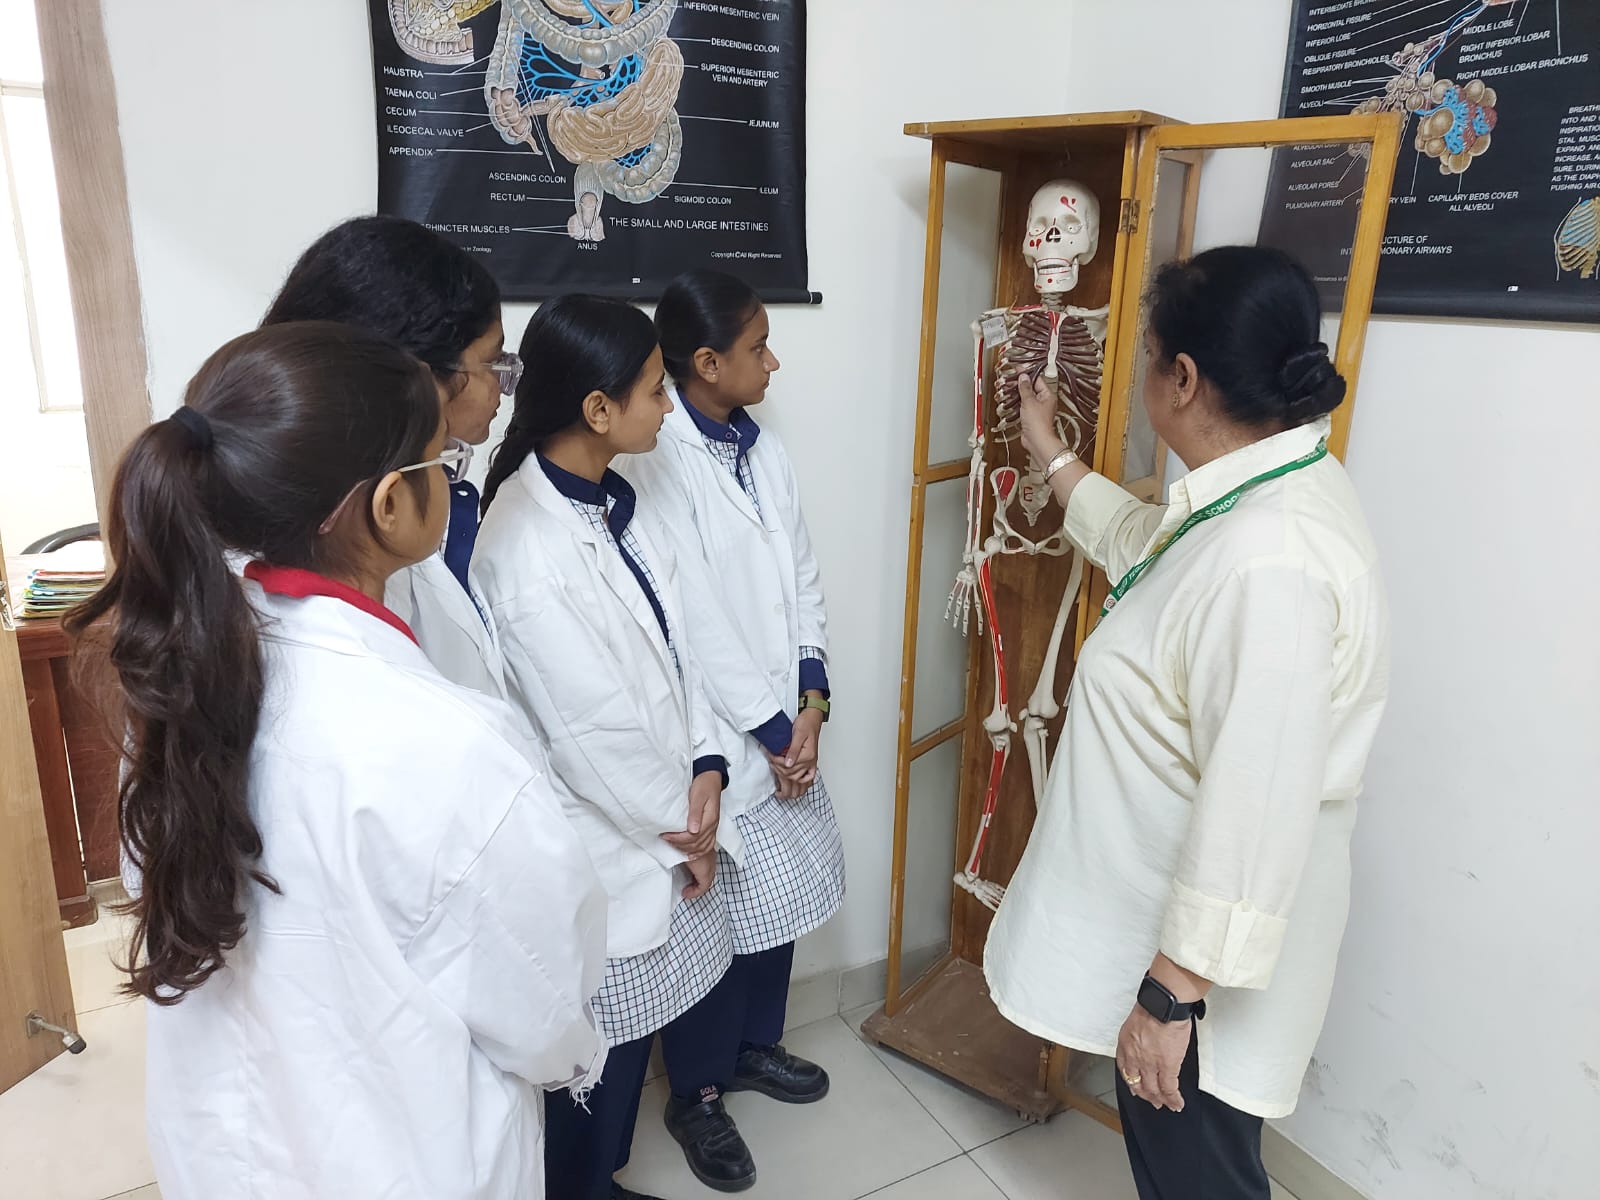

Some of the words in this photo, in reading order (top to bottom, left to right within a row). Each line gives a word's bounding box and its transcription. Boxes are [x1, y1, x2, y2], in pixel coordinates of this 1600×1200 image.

[684, 2, 718, 12] INFERIOR
[720, 6, 760, 19] MESENTERIC
[762, 12, 780, 21] VEIN
[1307, 19, 1345, 32] HORIZONTAL
[1346, 13, 1372, 24] FISSURE
[1462, 23, 1493, 35] MIDDLE
[1493, 19, 1515, 30] LOBE
[711, 37, 752, 51] DESCENDING
[754, 43, 780, 53] COLON
[1306, 36, 1335, 48] INFERIOR
[1336, 32, 1351, 41] LOBE
[1460, 42, 1485, 53] RIGHT
[1485, 36, 1521, 50] INFERIOR
[1522, 30, 1551, 42] LOBAR
[1304, 52, 1331, 63] OBLIQUE
[1332, 47, 1357, 58] FISSURE
[1459, 49, 1503, 64] BRONCHUS
[701, 62, 736, 74] SUPERIOR
[737, 66, 780, 79] MESENTERIC
[1302, 62, 1344, 76] RESPIRATORY
[1344, 54, 1390, 69] BRONCHIOLES
[1456, 70, 1481, 80] RIGHT
[1481, 65, 1509, 77] MIDDLE
[1510, 61, 1537, 73] LOBAR
[1538, 53, 1589, 69] BRONCHUS
[383, 66, 424, 78] HAUSTRA
[712, 74, 728, 83] VEIN
[729, 76, 742, 85] AND
[743, 78, 768, 88] ARTERY
[1300, 83, 1328, 94] SMOOTH
[1328, 80, 1352, 90] MUSCLE
[385, 87, 414, 99] TAENIA
[416, 91, 437, 100] COLI
[1299, 100, 1324, 109] ALVEOLI
[385, 106, 417, 117] CECUM
[749, 119, 780, 129] JEJUNUM
[1560, 116, 1579, 125] INTO
[1579, 114, 1597, 123] AND
[387, 124, 435, 136] ILEOCECAL
[436, 128, 464, 138] VALVE
[1558, 137, 1576, 145] STAL
[389, 146, 433, 156] APPENDIX
[1555, 144, 1586, 153] EXPAND
[1291, 159, 1321, 168] ALVEOLAR
[489, 172, 537, 183] ASCENDING
[538, 175, 567, 184] COLON
[1288, 182, 1318, 191] ALVEOLAR
[1318, 180, 1339, 189] PORES
[1550, 182, 1583, 191] PUSHING
[1583, 182, 1597, 190] AIR
[490, 193, 526, 202] RECTUM
[674, 195, 705, 204] SIGMOID
[706, 196, 732, 205] COLON
[1400, 196, 1417, 204] VEIN
[1428, 193, 1468, 203] CAPILLARY
[1469, 192, 1490, 201] BEDS
[1490, 191, 1519, 200] COVER
[1285, 200, 1321, 210] PULMONARY
[1321, 199, 1345, 208] ARTERY
[1449, 203, 1463, 211] ALL
[1463, 203, 1495, 211] ALVEOLI
[421, 223, 469, 233] PHINCTER
[470, 225, 510, 234] MUSCLES
[609, 217, 629, 228] THE
[631, 218, 663, 228] SMALL
[664, 219, 684, 229] AND
[686, 219, 718, 230] LARGE
[720, 221, 769, 231] INTESTINES
[1415, 235, 1429, 244] OF
[577, 242, 598, 251] ANUS
[1415, 245, 1453, 255] AIRWAYS
[710, 251, 734, 259] Copyright
